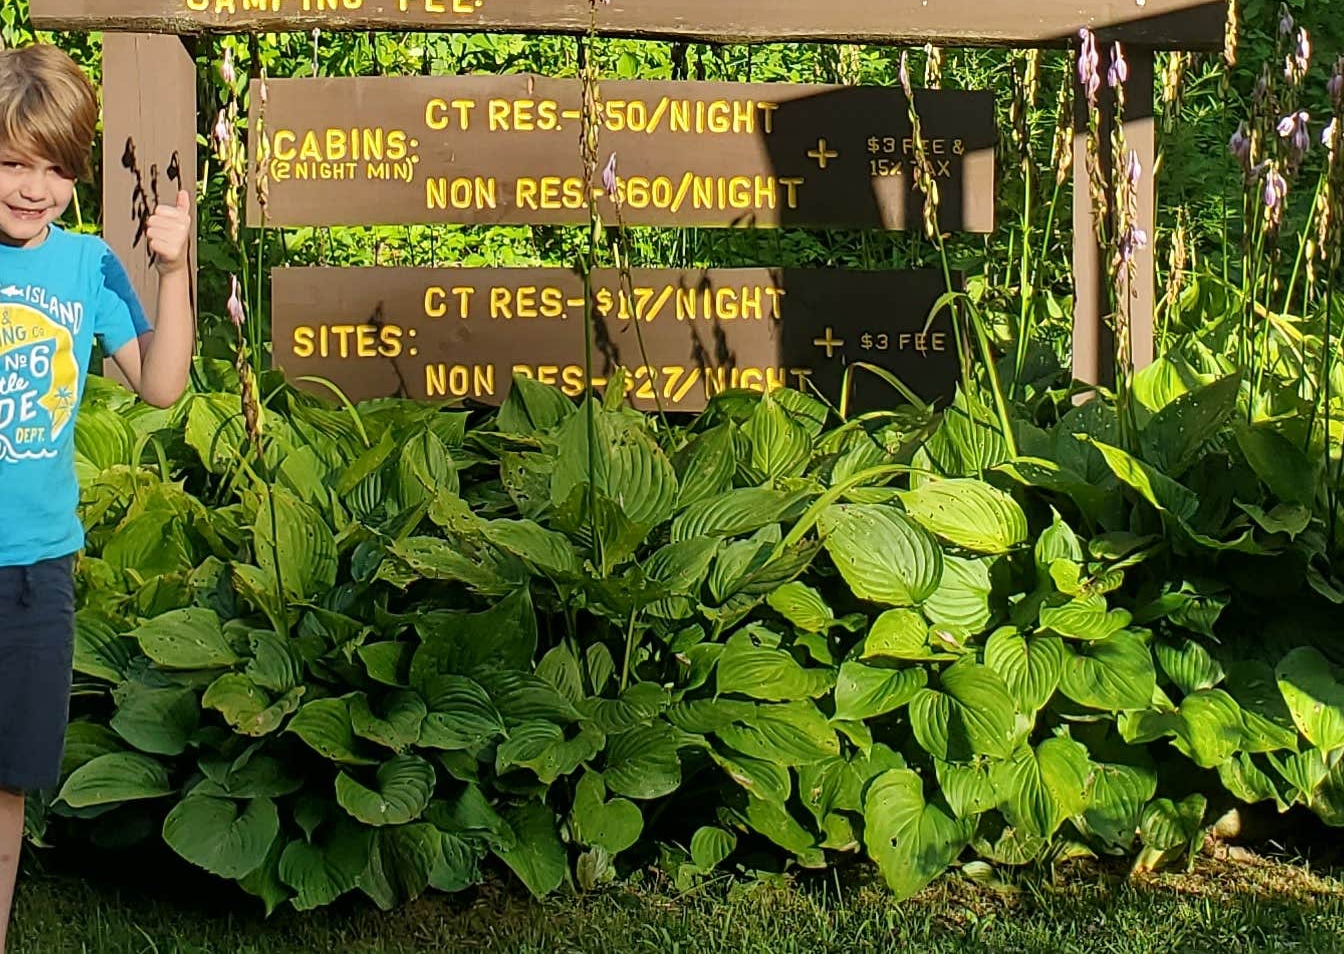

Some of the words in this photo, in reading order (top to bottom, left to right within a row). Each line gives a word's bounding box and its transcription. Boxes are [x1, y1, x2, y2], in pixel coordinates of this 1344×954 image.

[424, 98, 477, 131] CT
[273, 127, 420, 164] CABINS:
[867, 135, 896, 154] $3
[952, 138, 965, 155] &
[367, 157, 414, 183] MIN)
[909, 159, 951, 177] AX
[425, 177, 497, 210] NON
[1, 310, 13, 325] &
[25, 284, 84, 335] ISLAND
[424, 286, 475, 319] CT
[292, 324, 418, 358] SITES:
[861, 332, 889, 350] $3
[899, 333, 946, 351] FEE
[424, 363, 495, 397] NON
[15, 427, 45, 444] DEPT.
